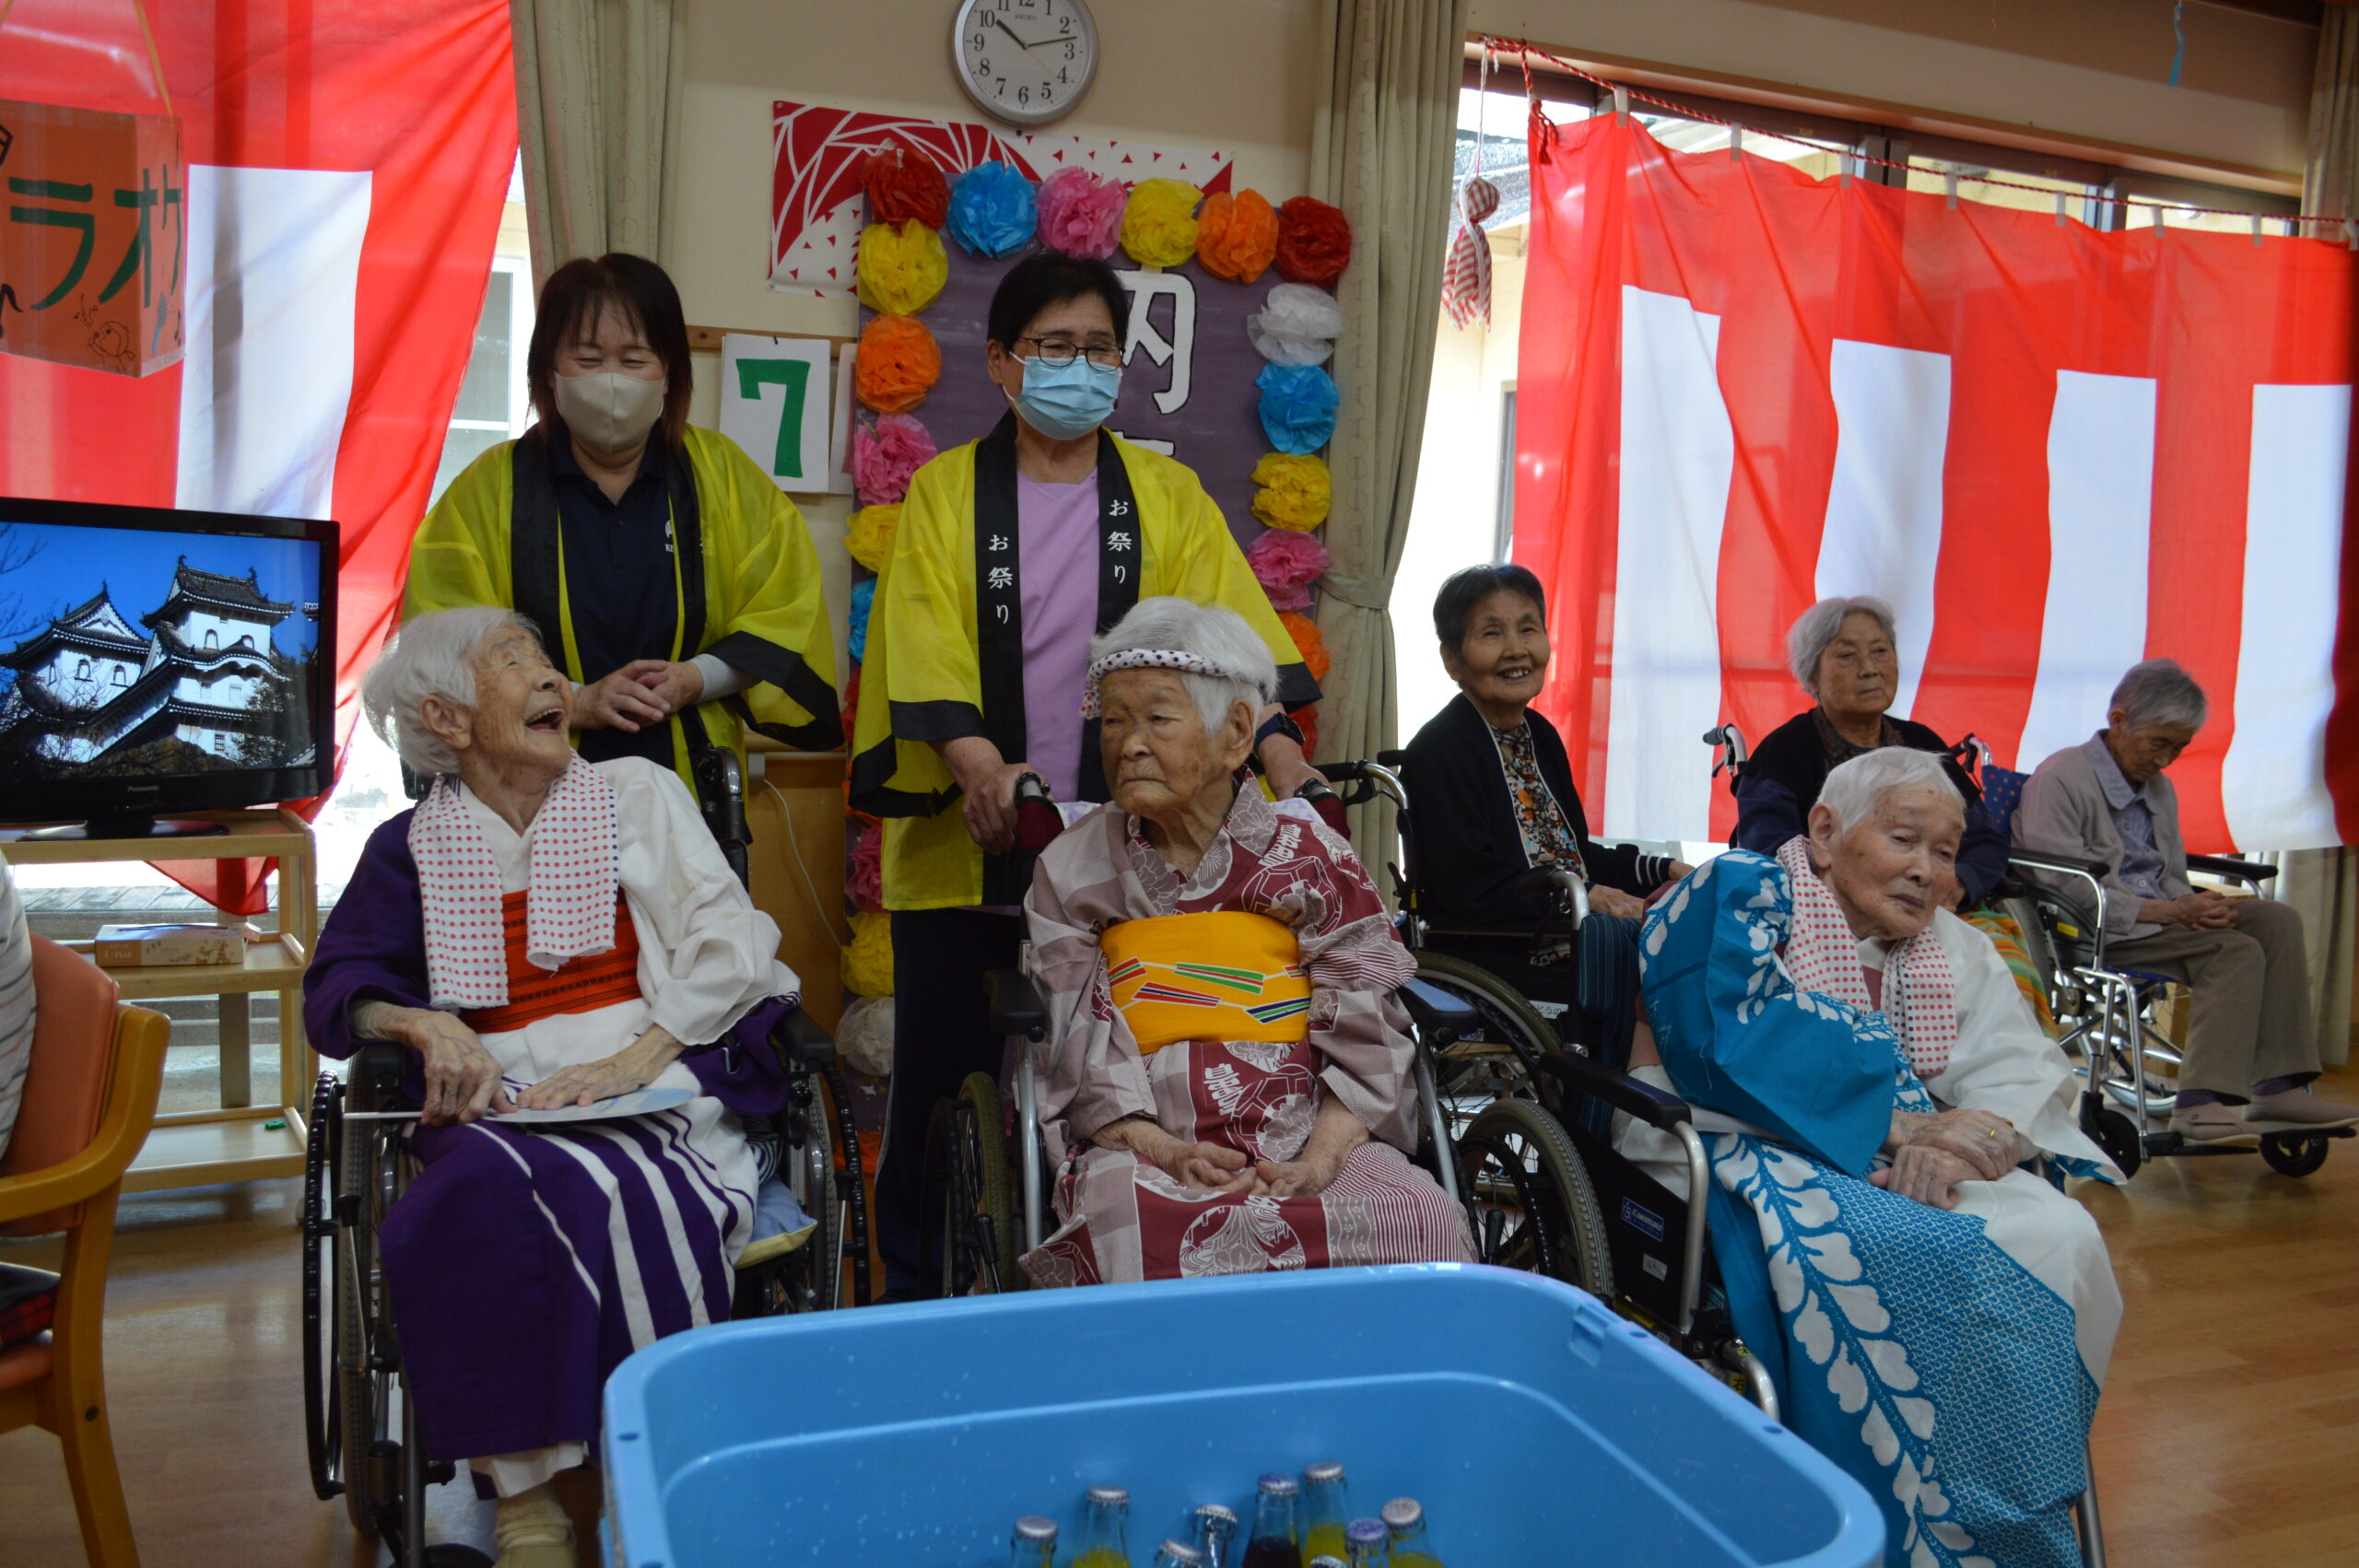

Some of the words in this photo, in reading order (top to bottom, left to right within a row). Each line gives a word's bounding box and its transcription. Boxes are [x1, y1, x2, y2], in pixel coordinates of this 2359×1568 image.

[1046, 0, 1051, 16] 1
[980, 9, 996, 28] 10
[1059, 16, 1070, 34] 2
[973, 33, 985, 52] 9
[1064, 42, 1074, 60] 3
[980, 58, 991, 76] 8
[1057, 66, 1069, 84] 4
[995, 77, 1006, 96] 7
[1018, 86, 1029, 104] 6
[1041, 82, 1051, 99] 5
[735, 358, 811, 478] 7
[1107, 499, 1133, 585] お祭り
[988, 534, 1014, 625] お祭り
